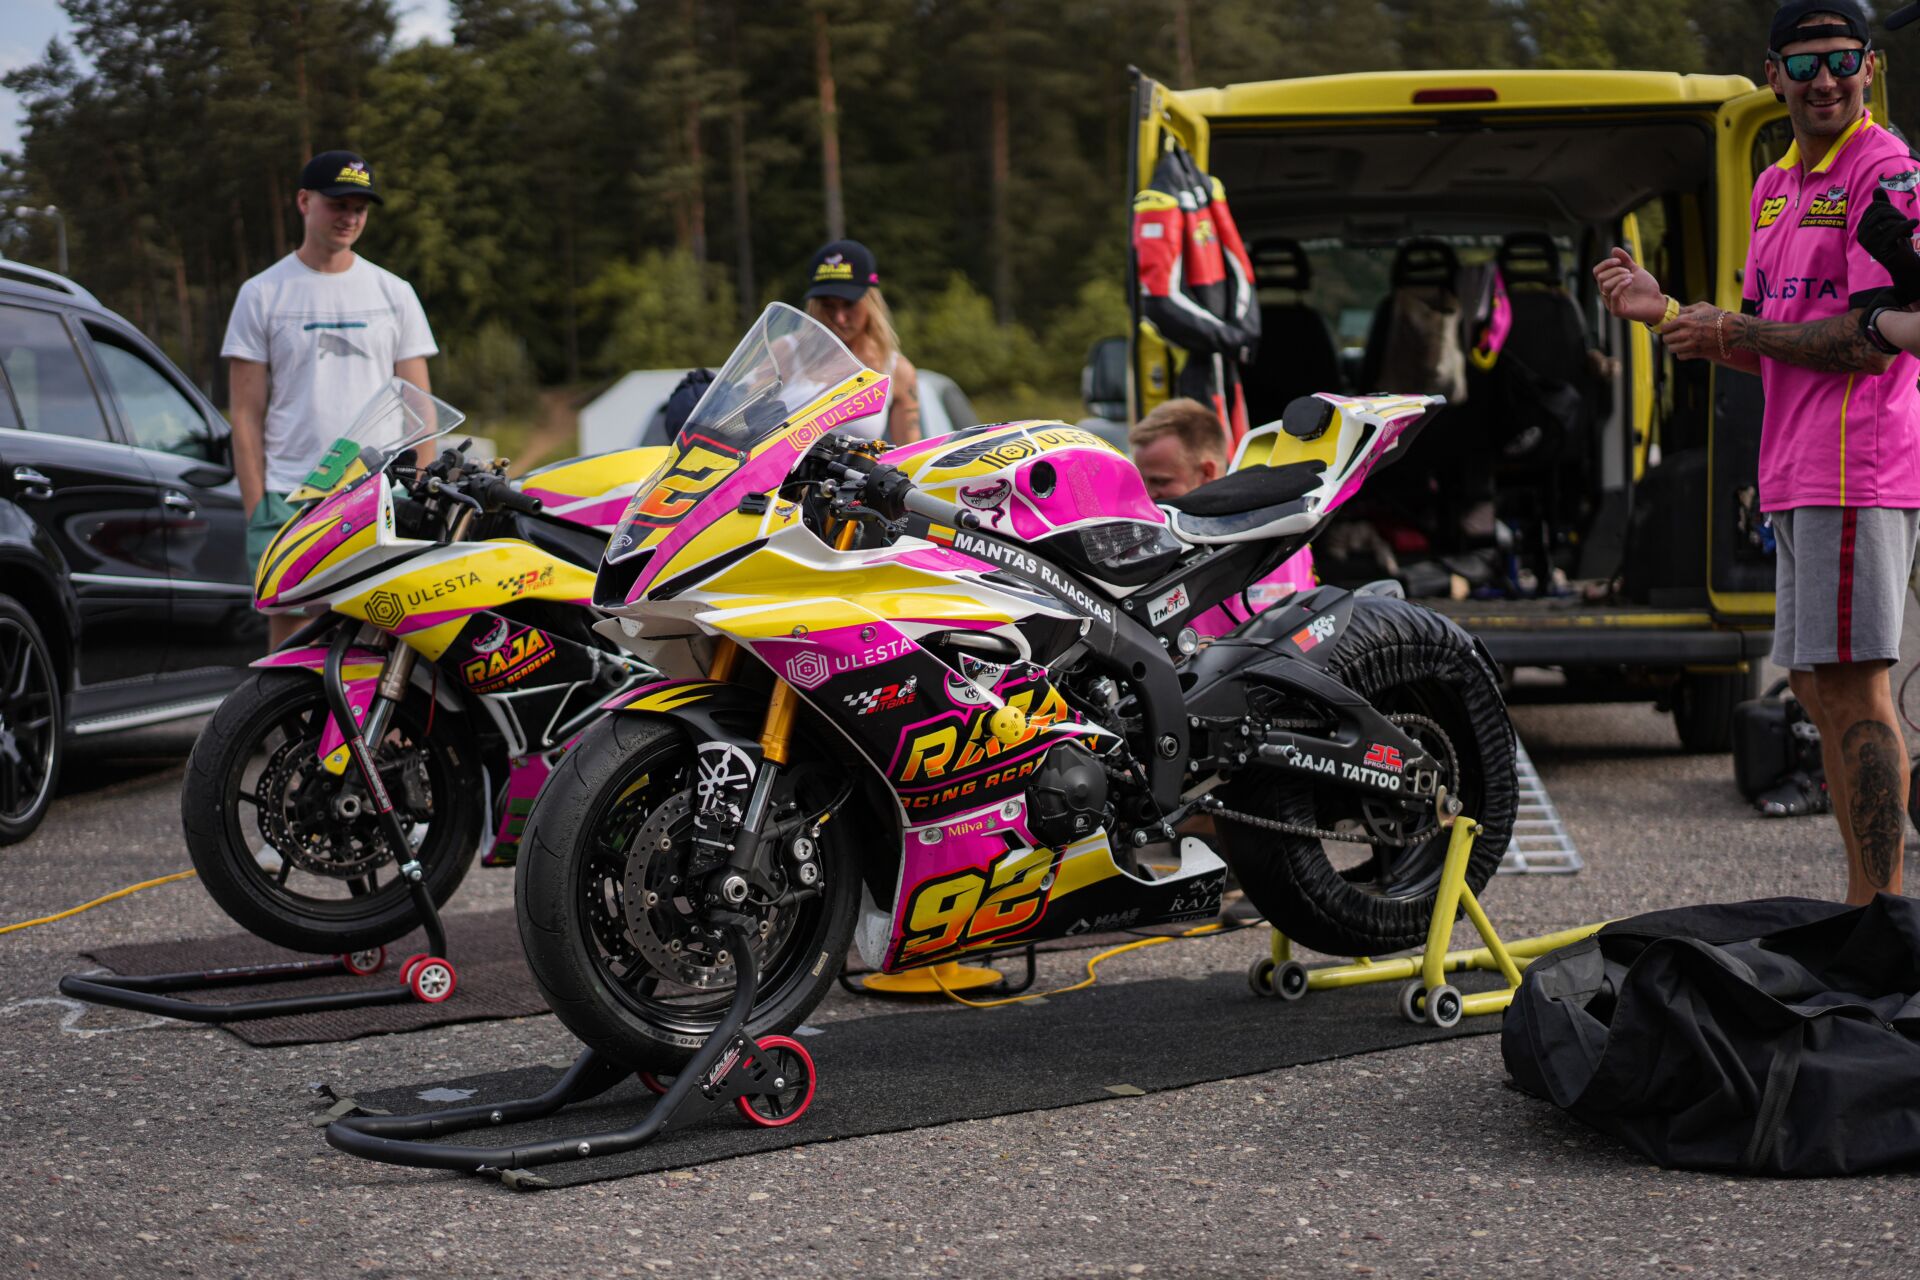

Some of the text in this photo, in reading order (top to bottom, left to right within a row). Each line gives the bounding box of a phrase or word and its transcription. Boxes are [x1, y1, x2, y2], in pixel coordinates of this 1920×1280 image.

[1757, 196, 1787, 228] 92
[823, 387, 885, 427] ULESTA
[630, 445, 740, 519] 2
[407, 571, 481, 607] ULESTA
[955, 533, 1111, 623] MANTAS RAJACKAS
[1308, 615, 1336, 644] K&N
[466, 628, 546, 684] RAJA
[836, 637, 912, 670] ULESTA
[1289, 751, 1400, 791] RAJA TATTOO
[1363, 760, 1402, 773] SPROCKETS
[900, 781, 977, 808] ACING
[948, 821, 983, 837] Milva
[901, 847, 1056, 961] 92
[1169, 893, 1223, 912] RAJA
